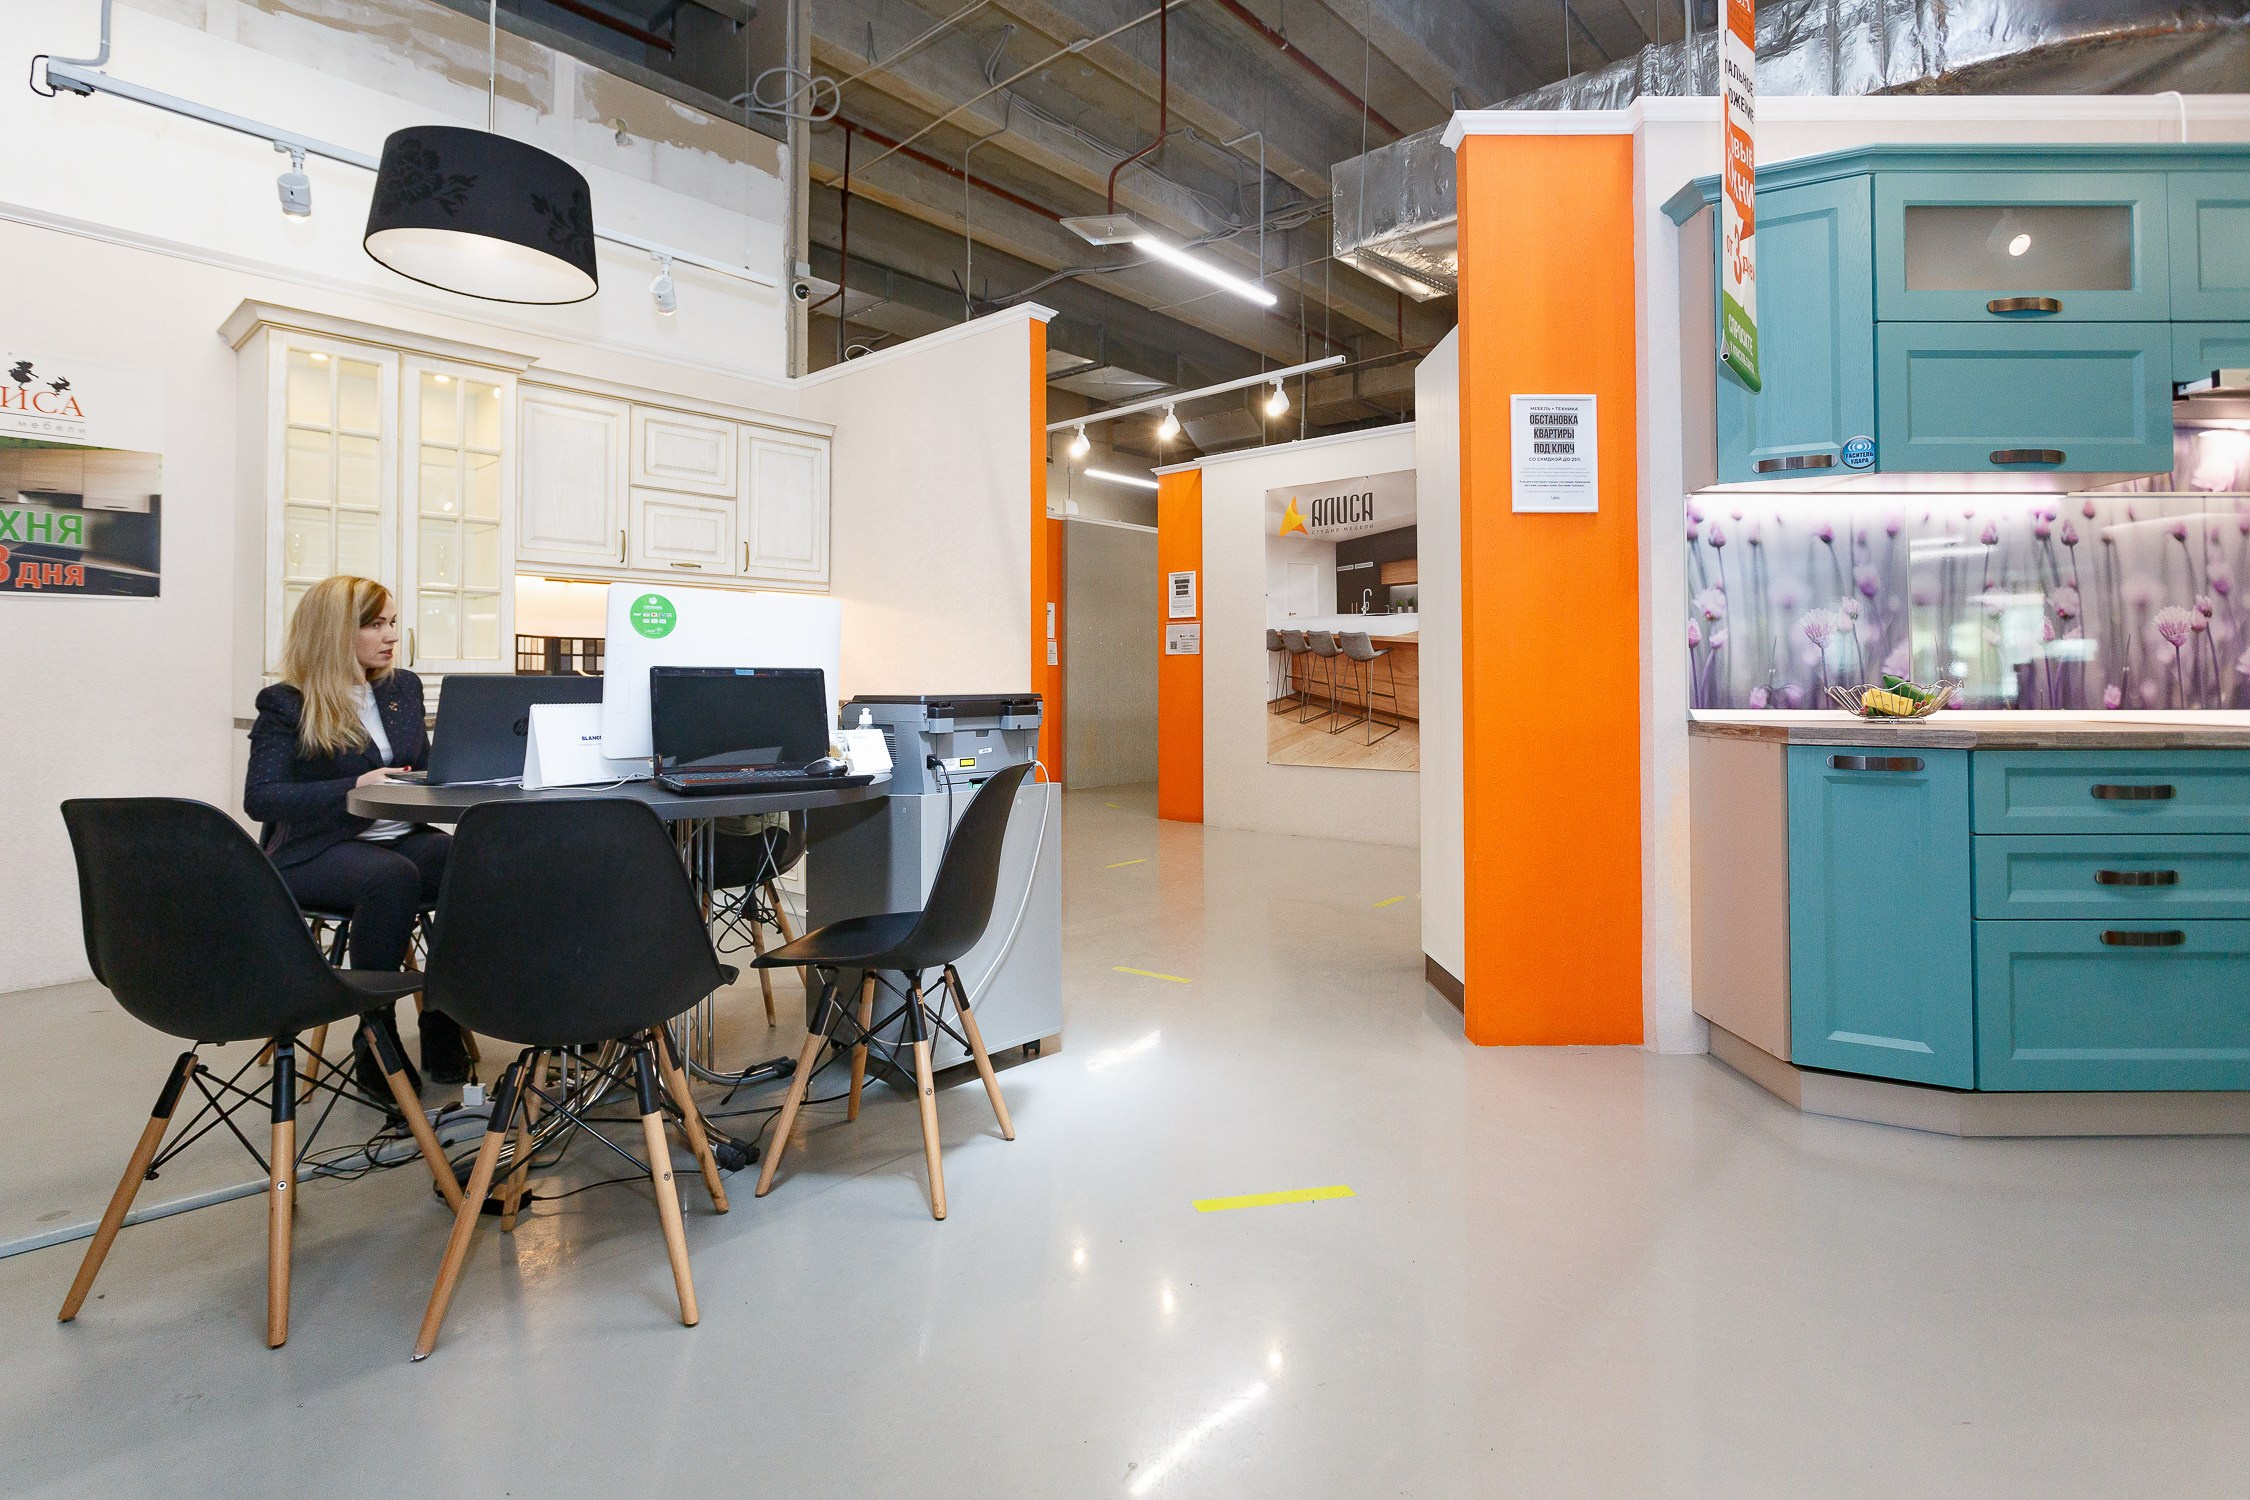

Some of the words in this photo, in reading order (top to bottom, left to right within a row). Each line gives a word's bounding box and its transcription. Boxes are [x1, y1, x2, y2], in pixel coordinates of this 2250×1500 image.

[1728, 87, 1754, 124] ОЖЕНИЕ
[0, 386, 85, 417] ИСА
[1529, 414, 1579, 425] ОБСТАНОВКА
[18, 421, 86, 434] мебели
[1533, 428, 1575, 439] КВАРТИРЫ
[1534, 443, 1551, 454] ПОД
[1551, 443, 1575, 454] КЛЮЧ
[1845, 451, 1874, 459] ГАСИТЕЛЬ
[0, 509, 82, 545] ХНЯ
